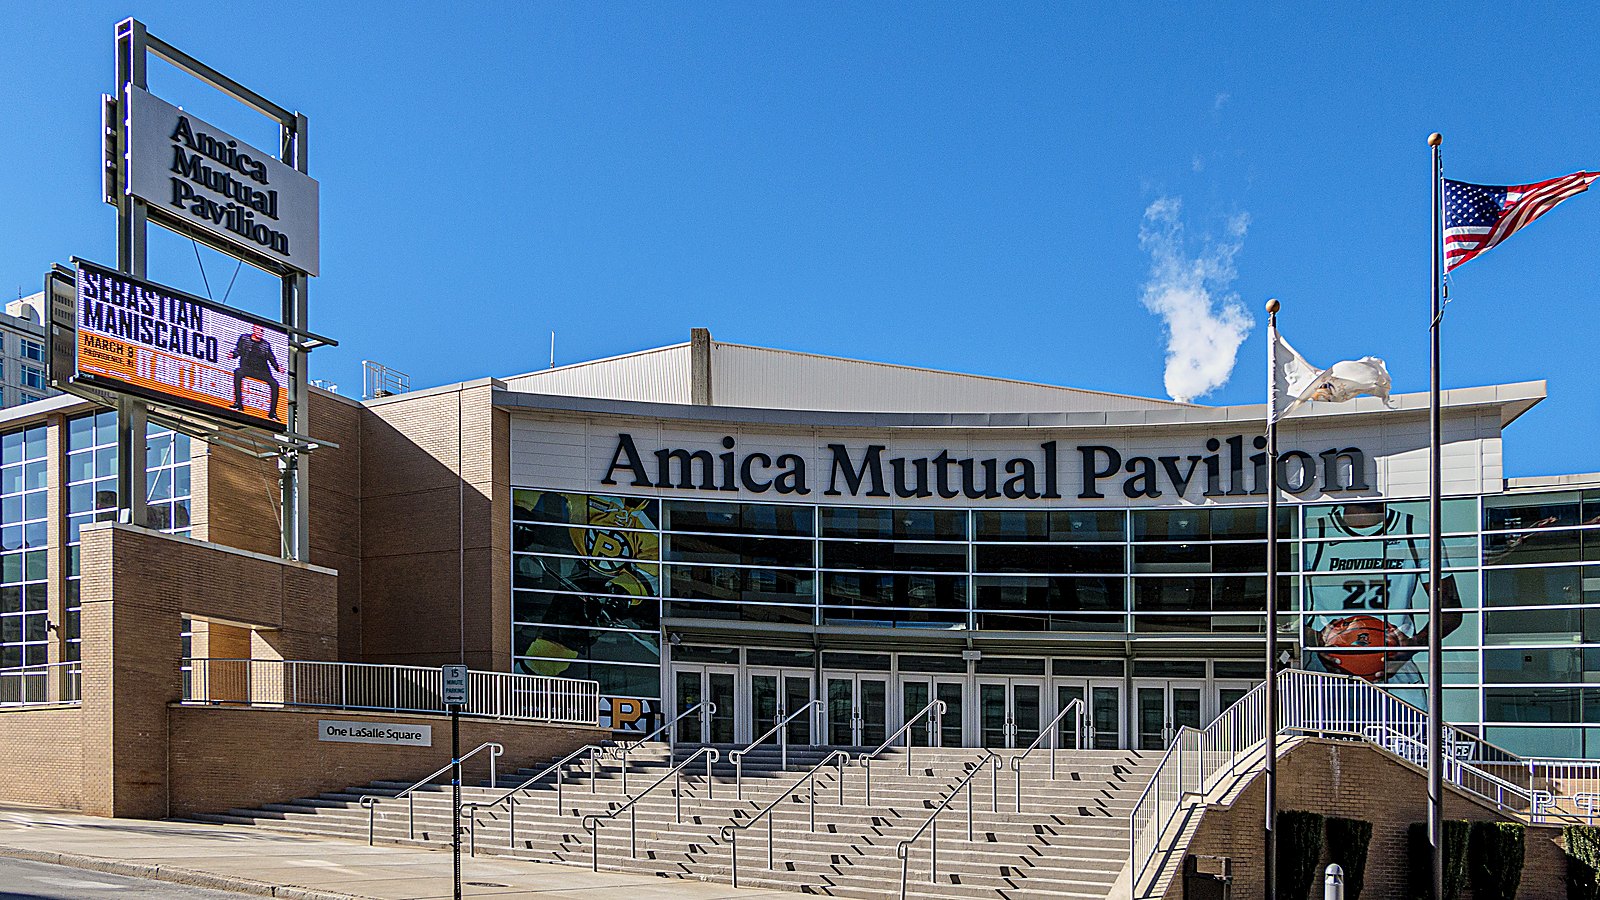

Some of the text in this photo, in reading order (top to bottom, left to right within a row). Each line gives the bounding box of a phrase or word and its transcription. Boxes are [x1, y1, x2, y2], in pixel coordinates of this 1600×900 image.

[170, 115, 269, 185] Amica
[170, 144, 279, 220] Mutual
[170, 176, 290, 256] Pavilion
[84, 269, 203, 332] SEBASTIAN
[84, 297, 218, 363] MANISCALCO
[84, 335, 124, 355] MARCH
[601, 433, 1370, 499] Amica Mutual Pavilion
[1329, 557, 1405, 571] PROVIDENCE
[1343, 579, 1392, 609] 23
[451, 669, 459, 678] 15
[326, 726, 422, 741] One LaSalle Square
